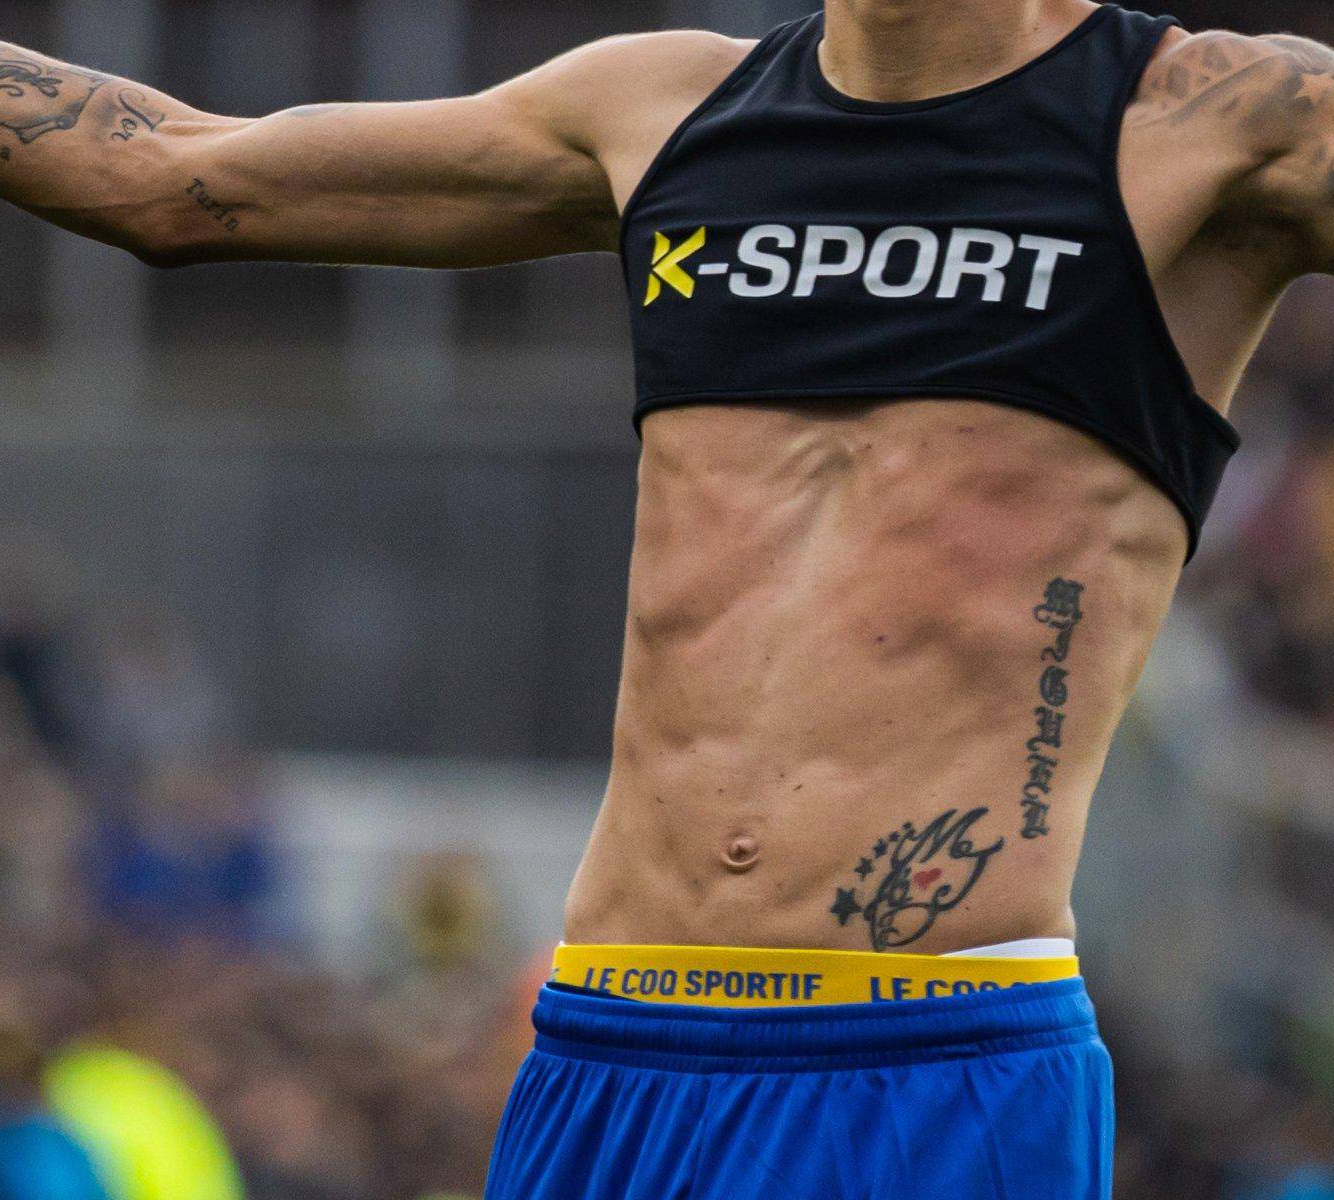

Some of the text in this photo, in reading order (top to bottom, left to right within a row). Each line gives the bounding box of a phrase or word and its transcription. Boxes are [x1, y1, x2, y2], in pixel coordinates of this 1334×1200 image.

[643, 224, 1084, 311] K-SPORT
[583, 967, 616, 995] LE
[621, 968, 678, 997] COQ
[683, 969, 823, 1001] SPORTIF
[869, 976, 913, 1003] LE
